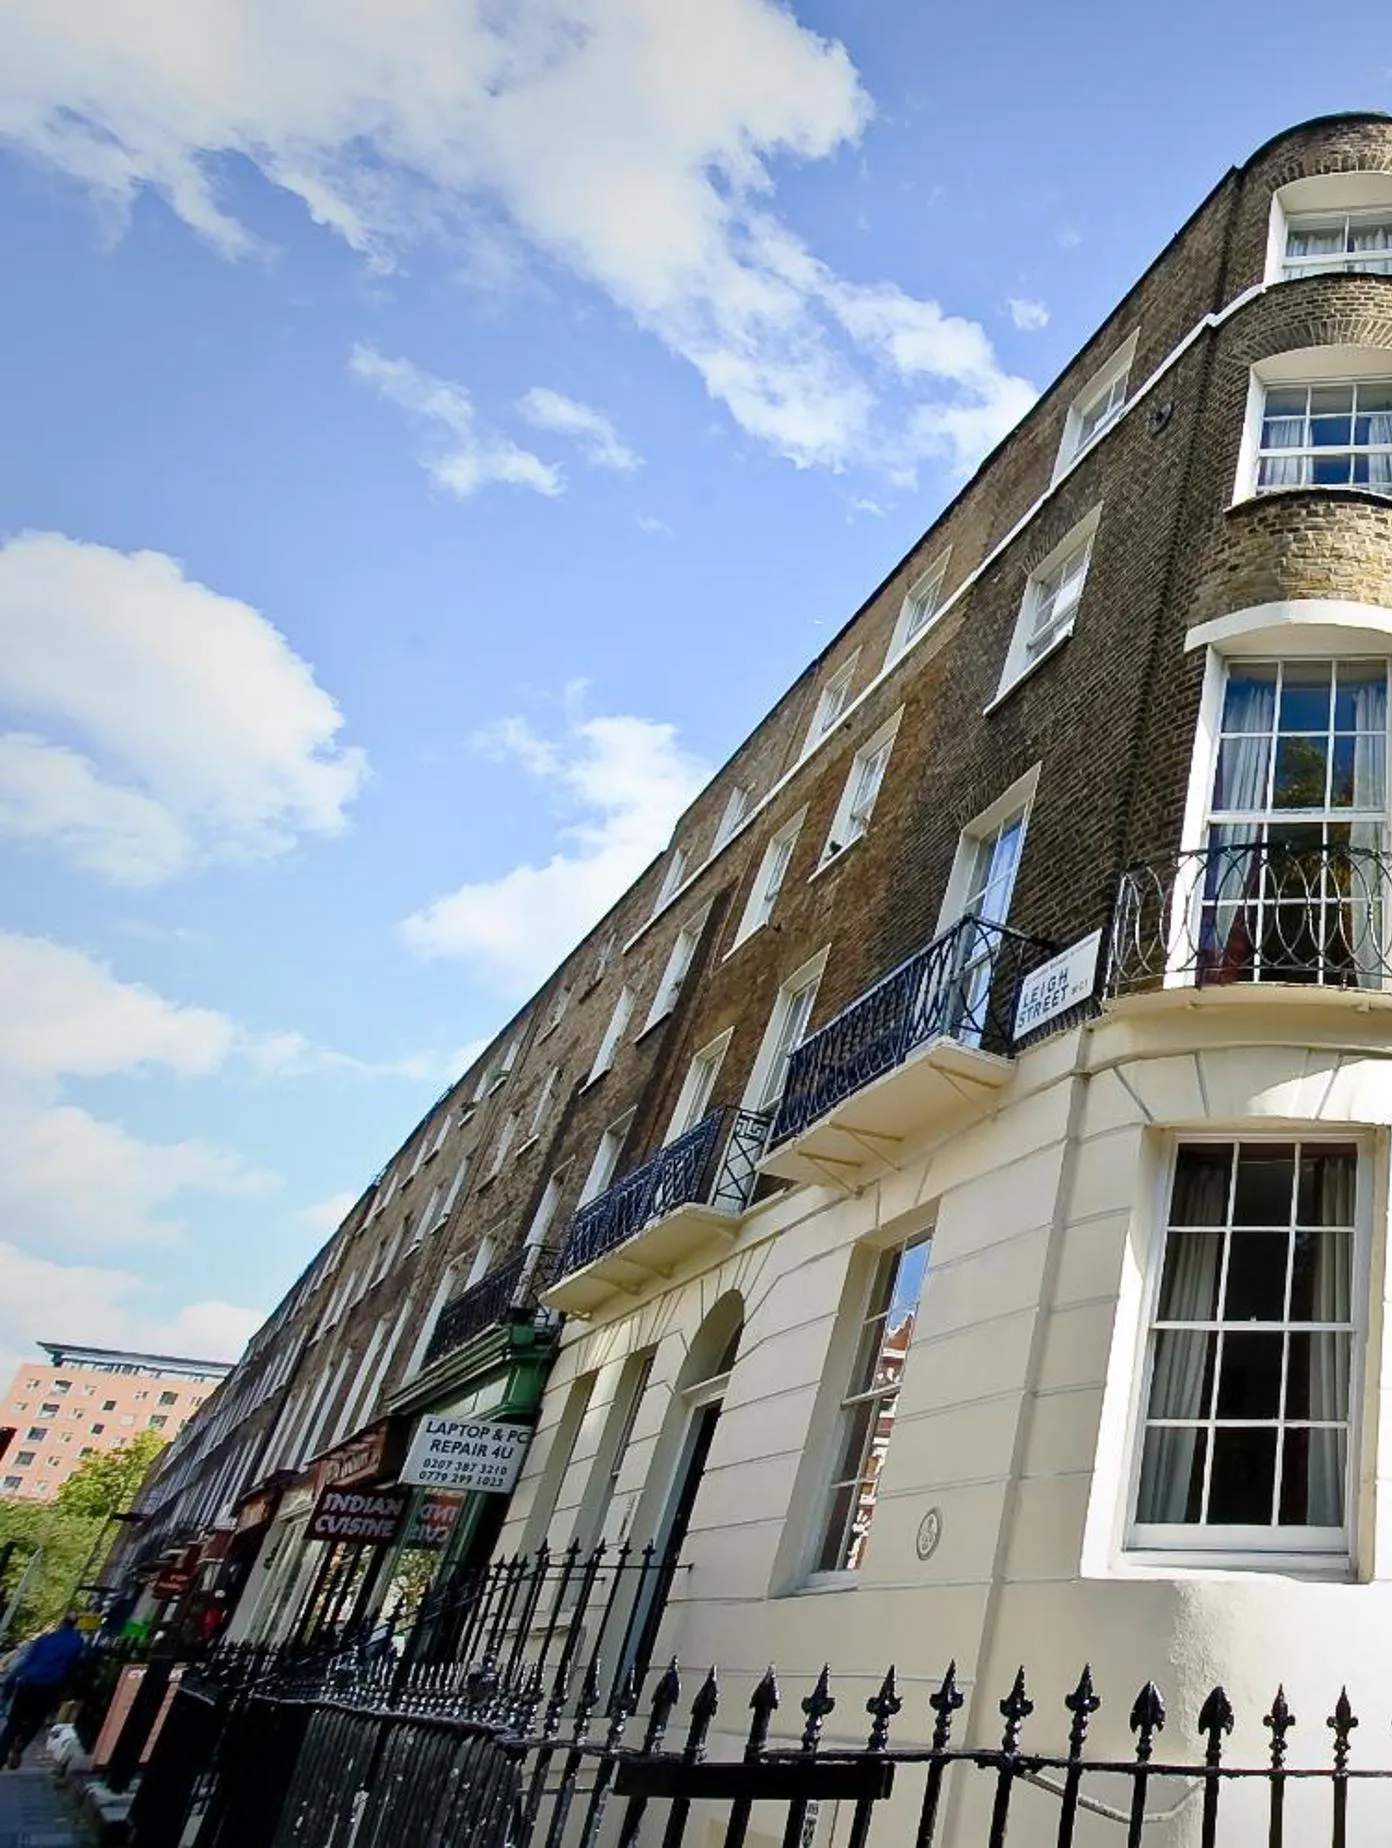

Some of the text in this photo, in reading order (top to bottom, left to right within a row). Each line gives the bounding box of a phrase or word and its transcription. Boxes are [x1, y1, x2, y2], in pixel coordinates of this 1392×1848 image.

[1023, 967, 1069, 1008] LEIGH
[1018, 984, 1069, 1028] STREET
[426, 1420, 529, 1444] LAPTOP & PC
[429, 1439, 514, 1459] REPAIR 4U
[322, 1492, 403, 1517] INDIAN
[314, 1514, 395, 1537] CUISINE
